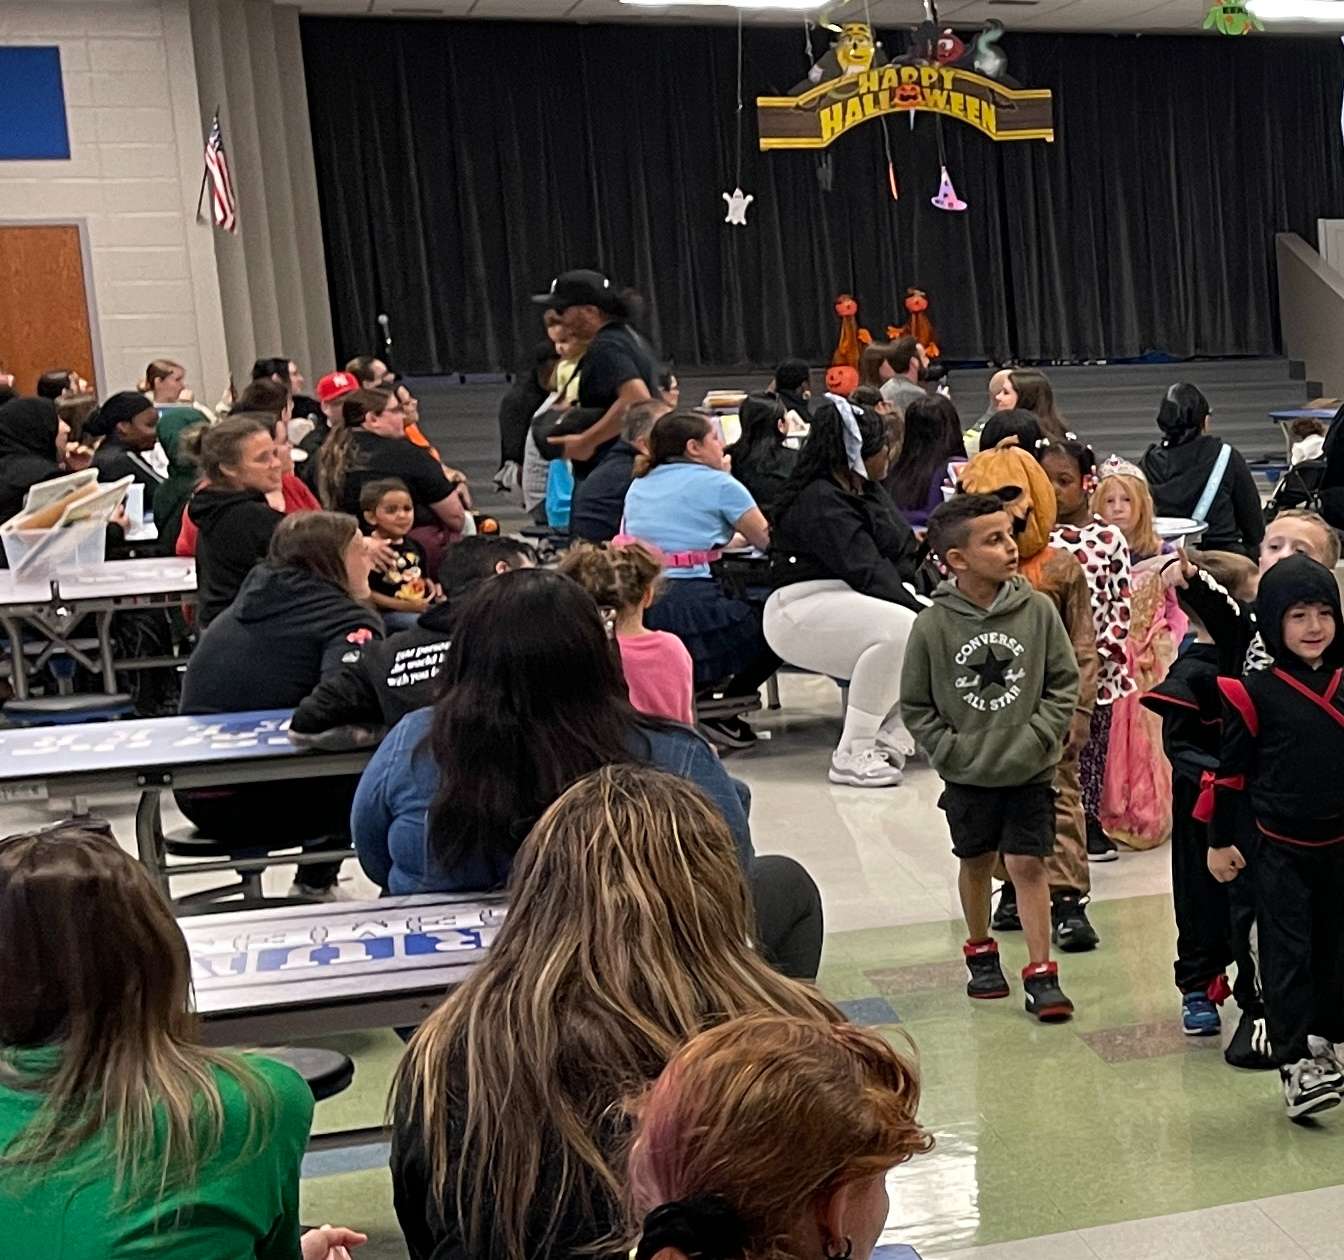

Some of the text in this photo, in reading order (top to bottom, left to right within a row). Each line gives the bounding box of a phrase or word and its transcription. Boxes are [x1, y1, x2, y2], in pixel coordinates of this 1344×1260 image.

[858, 66, 956, 94] HAPPY
[955, 631, 1025, 665] CONVERSE
[962, 684, 1022, 711] ALL STAR
